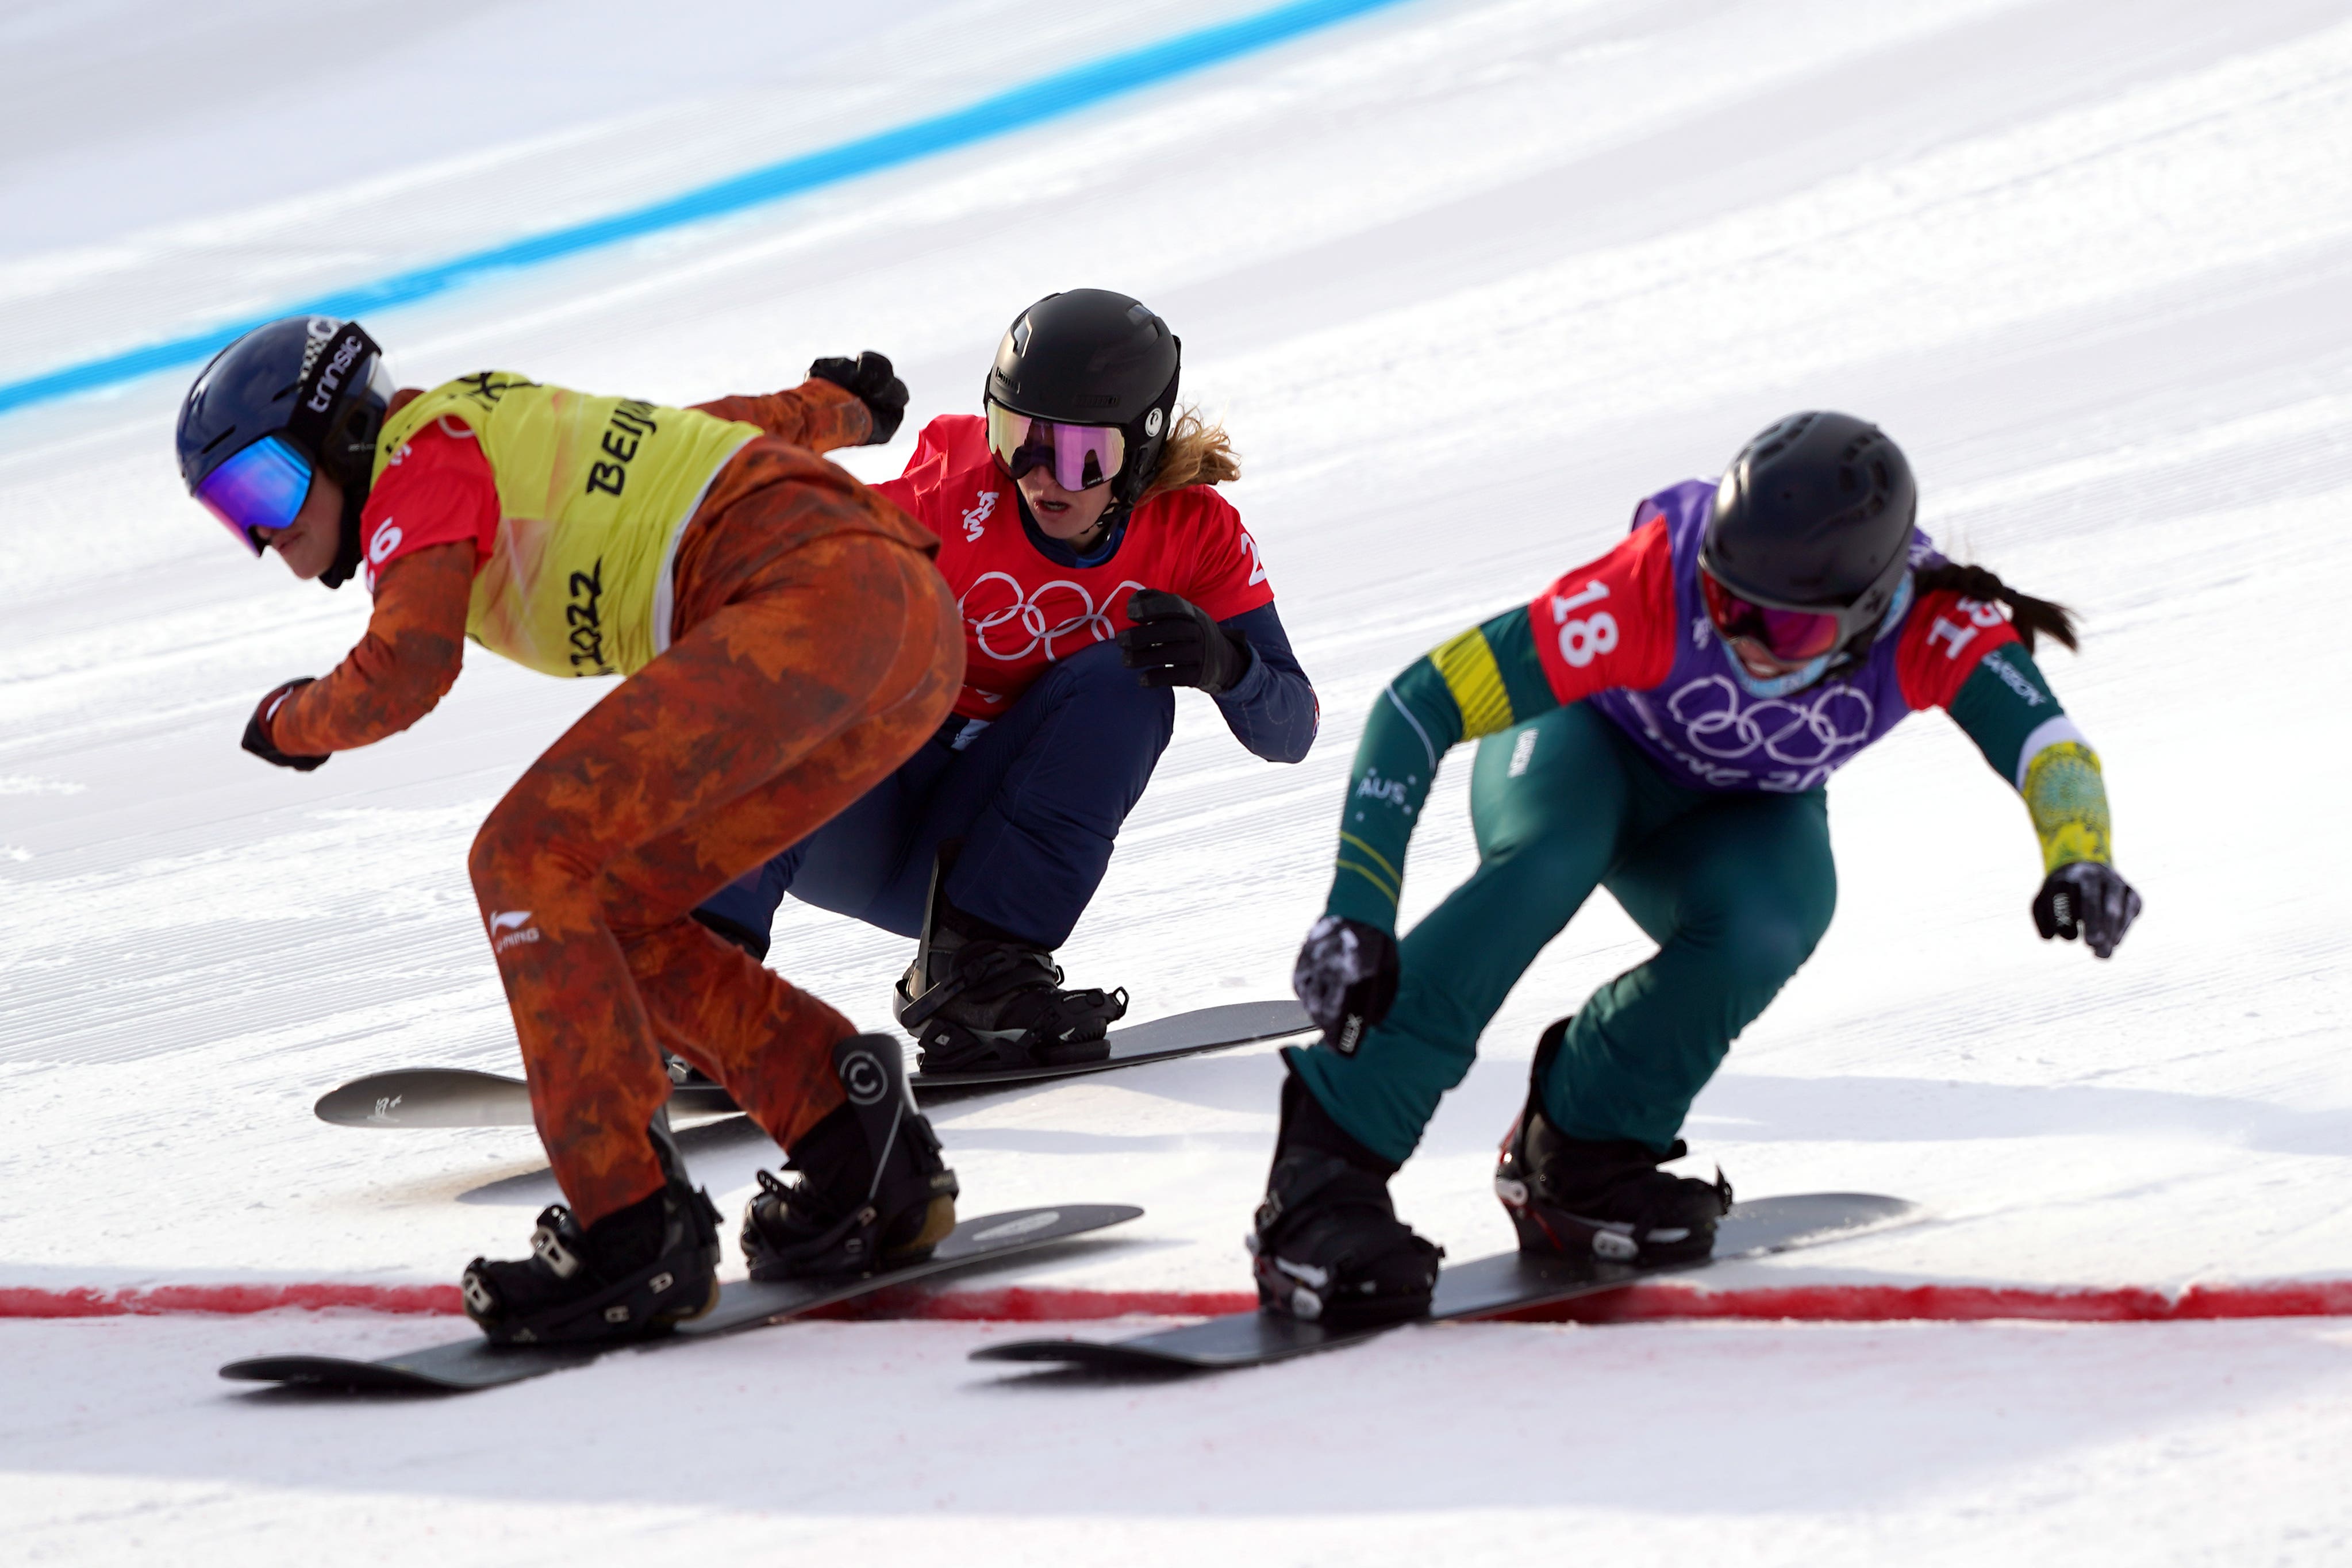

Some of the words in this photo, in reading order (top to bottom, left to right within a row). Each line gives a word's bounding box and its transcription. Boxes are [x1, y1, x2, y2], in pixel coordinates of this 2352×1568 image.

[585, 399, 658, 497] BEIJ
[1551, 579, 1620, 668] 18
[1355, 777, 1408, 805] AUS
